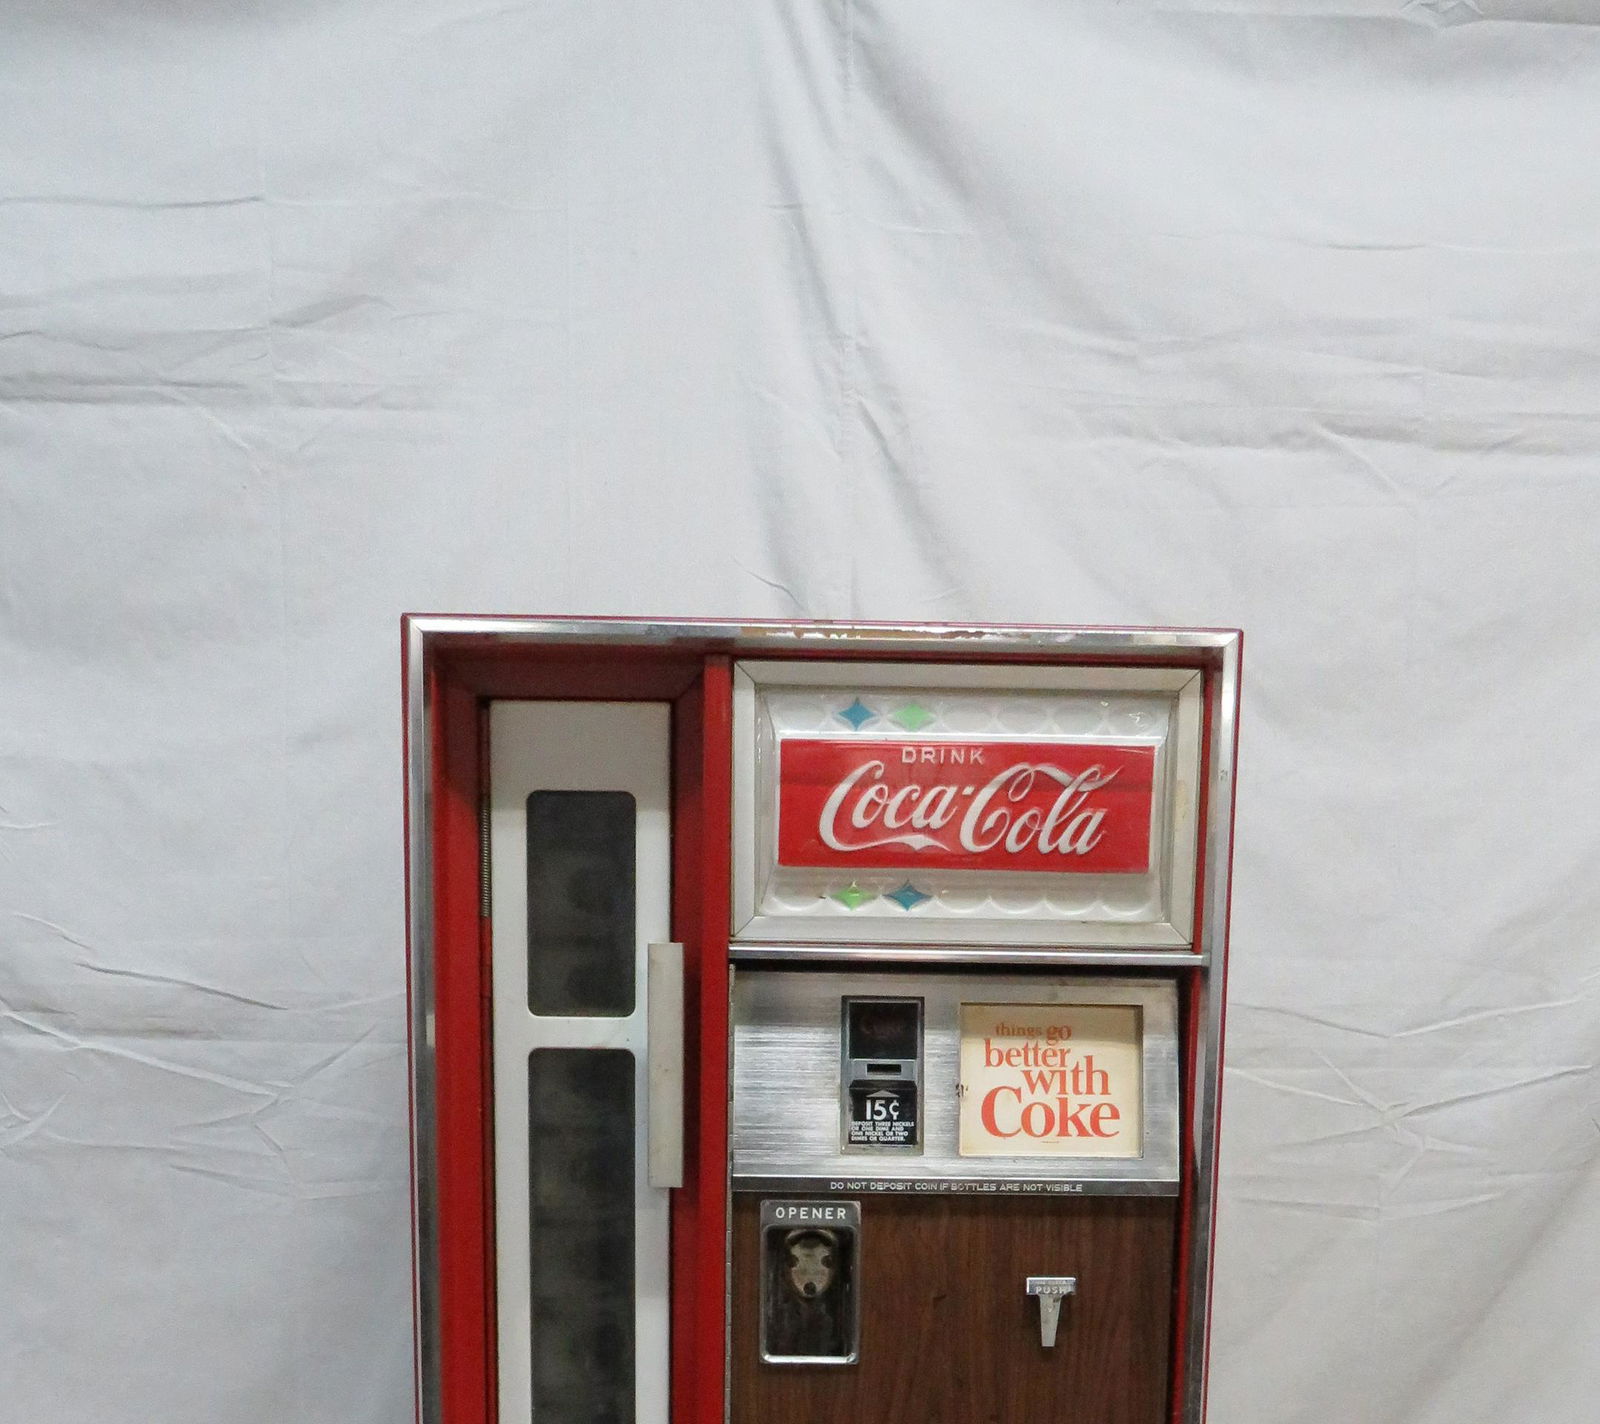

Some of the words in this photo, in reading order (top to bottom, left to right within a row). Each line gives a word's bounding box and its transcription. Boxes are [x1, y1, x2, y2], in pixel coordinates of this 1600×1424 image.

[901, 746, 985, 765] DRINK
[818, 759, 1124, 855] Coca-Cola
[995, 1022, 1042, 1040] things
[1045, 1025, 1072, 1046] go
[983, 1038, 1071, 1068] better
[1021, 1055, 1111, 1096] with
[865, 1099, 900, 1121] 15¢
[981, 1085, 1121, 1138] Coke
[830, 1181, 845, 1190] DO
[846, 1181, 868, 1190] NOT
[869, 1182, 913, 1191] DEPOSIT
[914, 1182, 938, 1191] COIN
[939, 1182, 949, 1191] IF
[950, 1183, 997, 1192] BOTTLES
[999, 1183, 1020, 1192] ARE
[1022, 1183, 1043, 1192] NOT
[1045, 1183, 1083, 1192] VISIBLE
[775, 1206, 847, 1220] OPENER
[1035, 1286, 1067, 1295] PUSH
